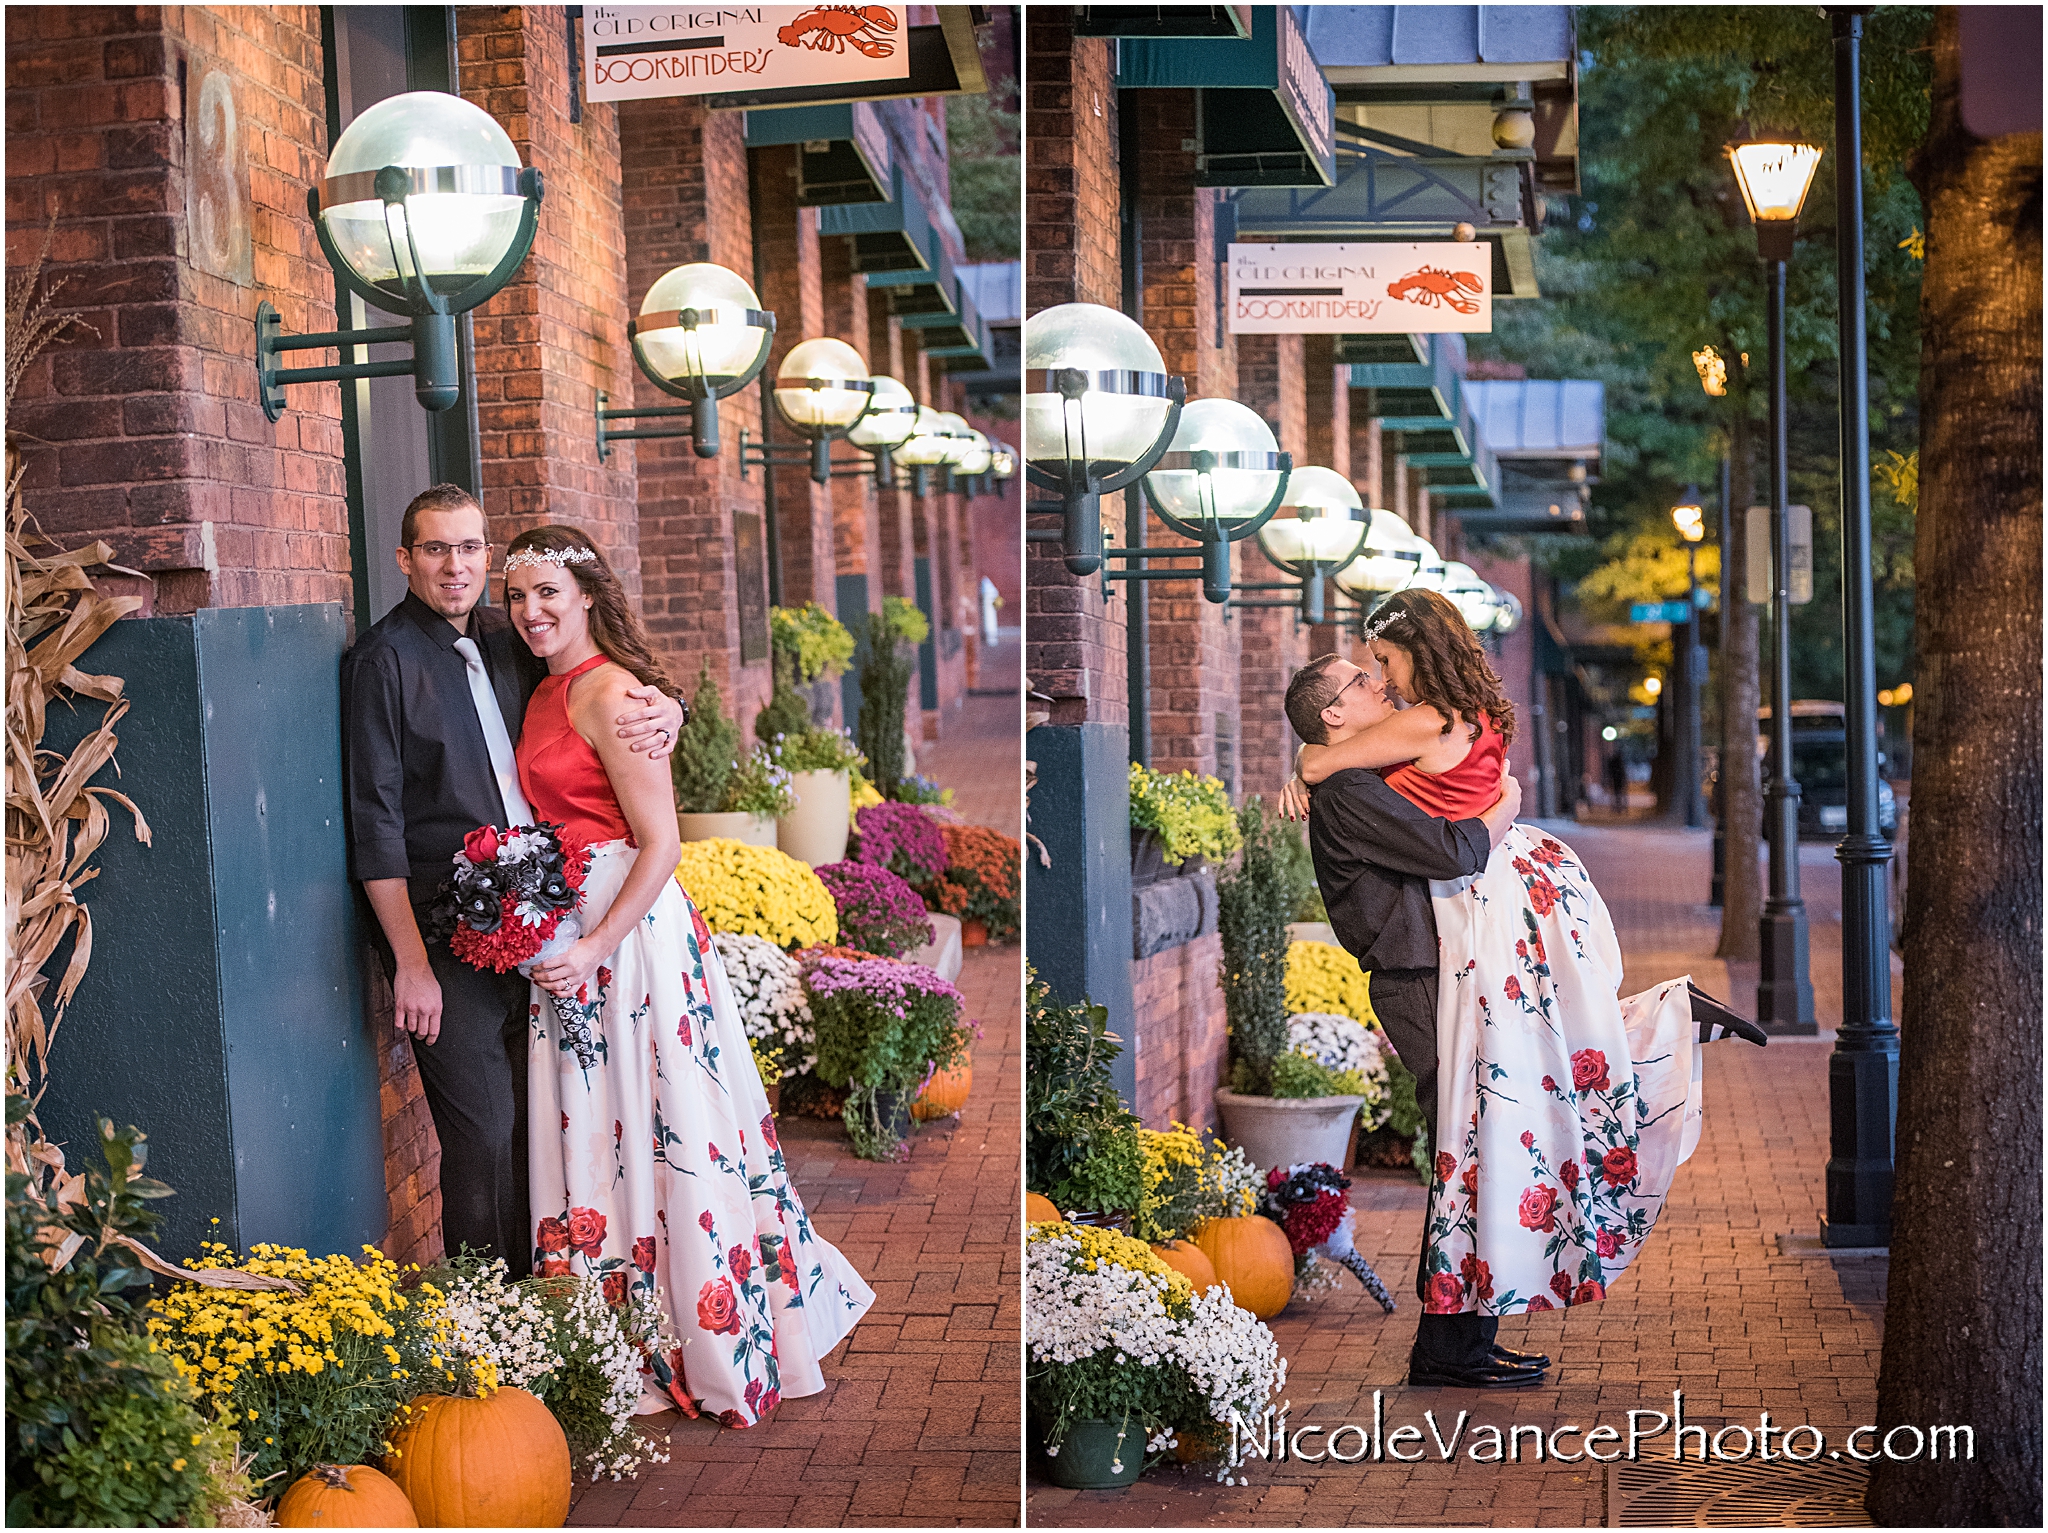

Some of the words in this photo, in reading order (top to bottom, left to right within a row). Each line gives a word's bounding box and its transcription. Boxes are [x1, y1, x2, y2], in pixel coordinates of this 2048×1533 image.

[593, 19, 644, 36] OLD
[649, 8, 769, 32] ORIGINAL
[594, 7, 620, 19] the
[595, 48, 774, 84] BOOKBINDER'S
[1236, 266, 1279, 280] OLD
[1283, 266, 1378, 279] ORIGINAL
[1236, 299, 1382, 320] BOOKBINDER'S
